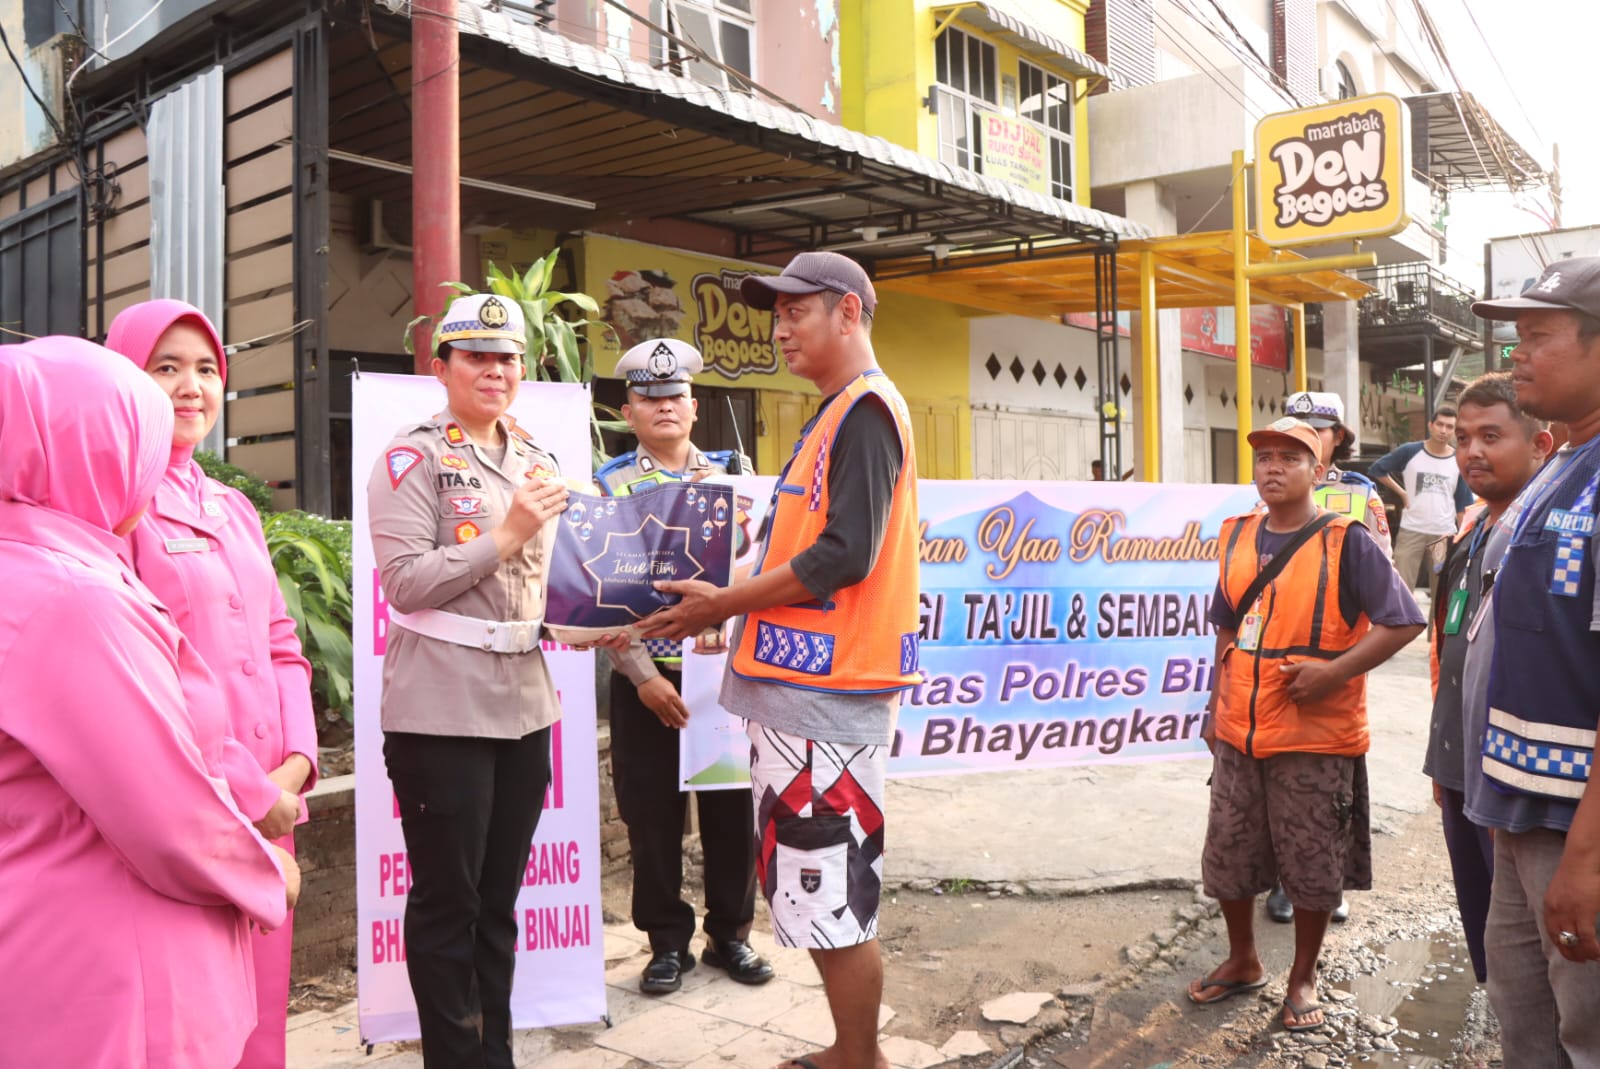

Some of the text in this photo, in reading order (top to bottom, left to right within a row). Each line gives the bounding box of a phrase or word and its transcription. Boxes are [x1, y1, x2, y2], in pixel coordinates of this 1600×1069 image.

[987, 116, 1041, 154] DIJUAL
[1307, 114, 1380, 142] martabak
[1273, 130, 1381, 194] DeN
[1277, 182, 1385, 224] Bagoes
[701, 334, 775, 370] Bagoes
[916, 506, 1220, 581] ban Yaa Ramadha
[1545, 511, 1594, 532] ISHUB
[918, 592, 944, 641] GI
[963, 593, 1057, 641] TA'JIL
[1066, 592, 1087, 639] &
[899, 669, 985, 707] tas
[999, 661, 1148, 702] Polres
[920, 706, 1212, 762] Bhayangkari
[519, 840, 581, 888] BANG
[525, 903, 591, 951] BINJAI
